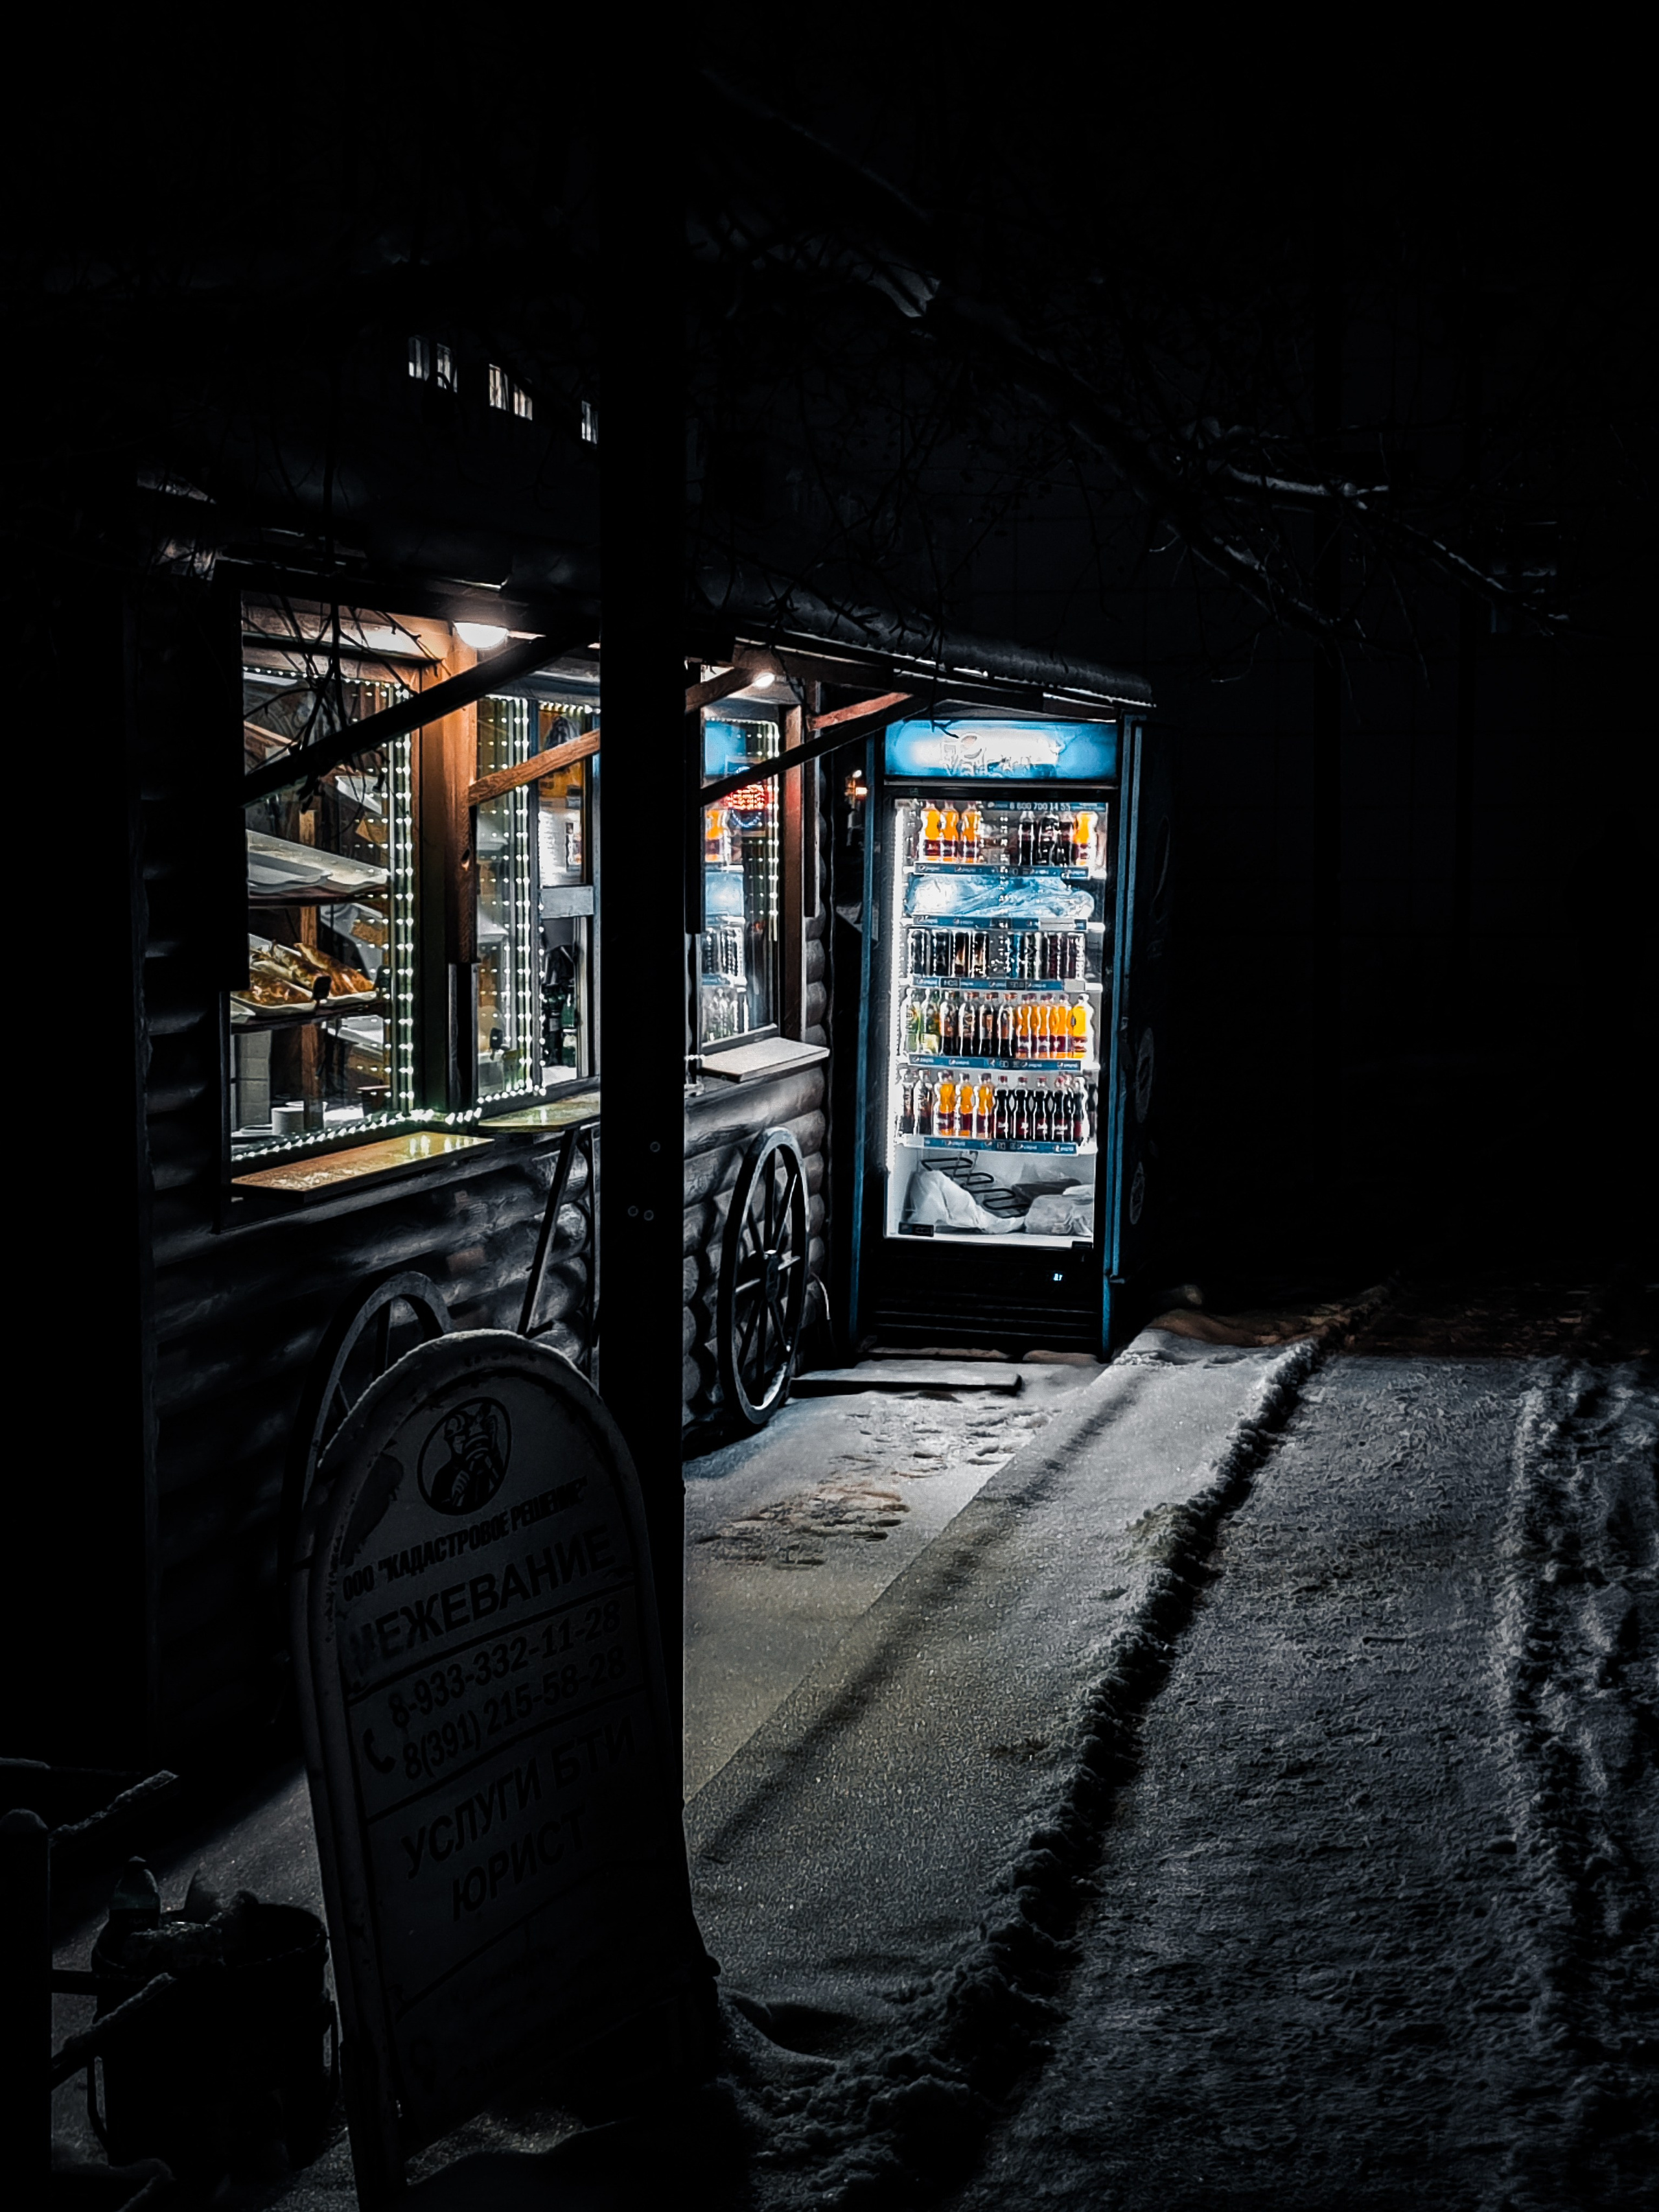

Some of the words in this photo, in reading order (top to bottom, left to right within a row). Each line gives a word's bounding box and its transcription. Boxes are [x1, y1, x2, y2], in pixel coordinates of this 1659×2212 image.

[343, 1565, 375, 1601] ООО
[378, 1511, 510, 1582] "КАДАСТРОВОЕ
[389, 1600, 621, 1728] 8-933-332-11-28
[402, 1709, 481, 1780] 8(391)
[484, 1646, 627, 1736] 215-58-28
[401, 1758, 542, 1880] УСЛУГИ
[551, 1716, 636, 1789] БТИ
[452, 1803, 586, 1922] ЮРИСТ
